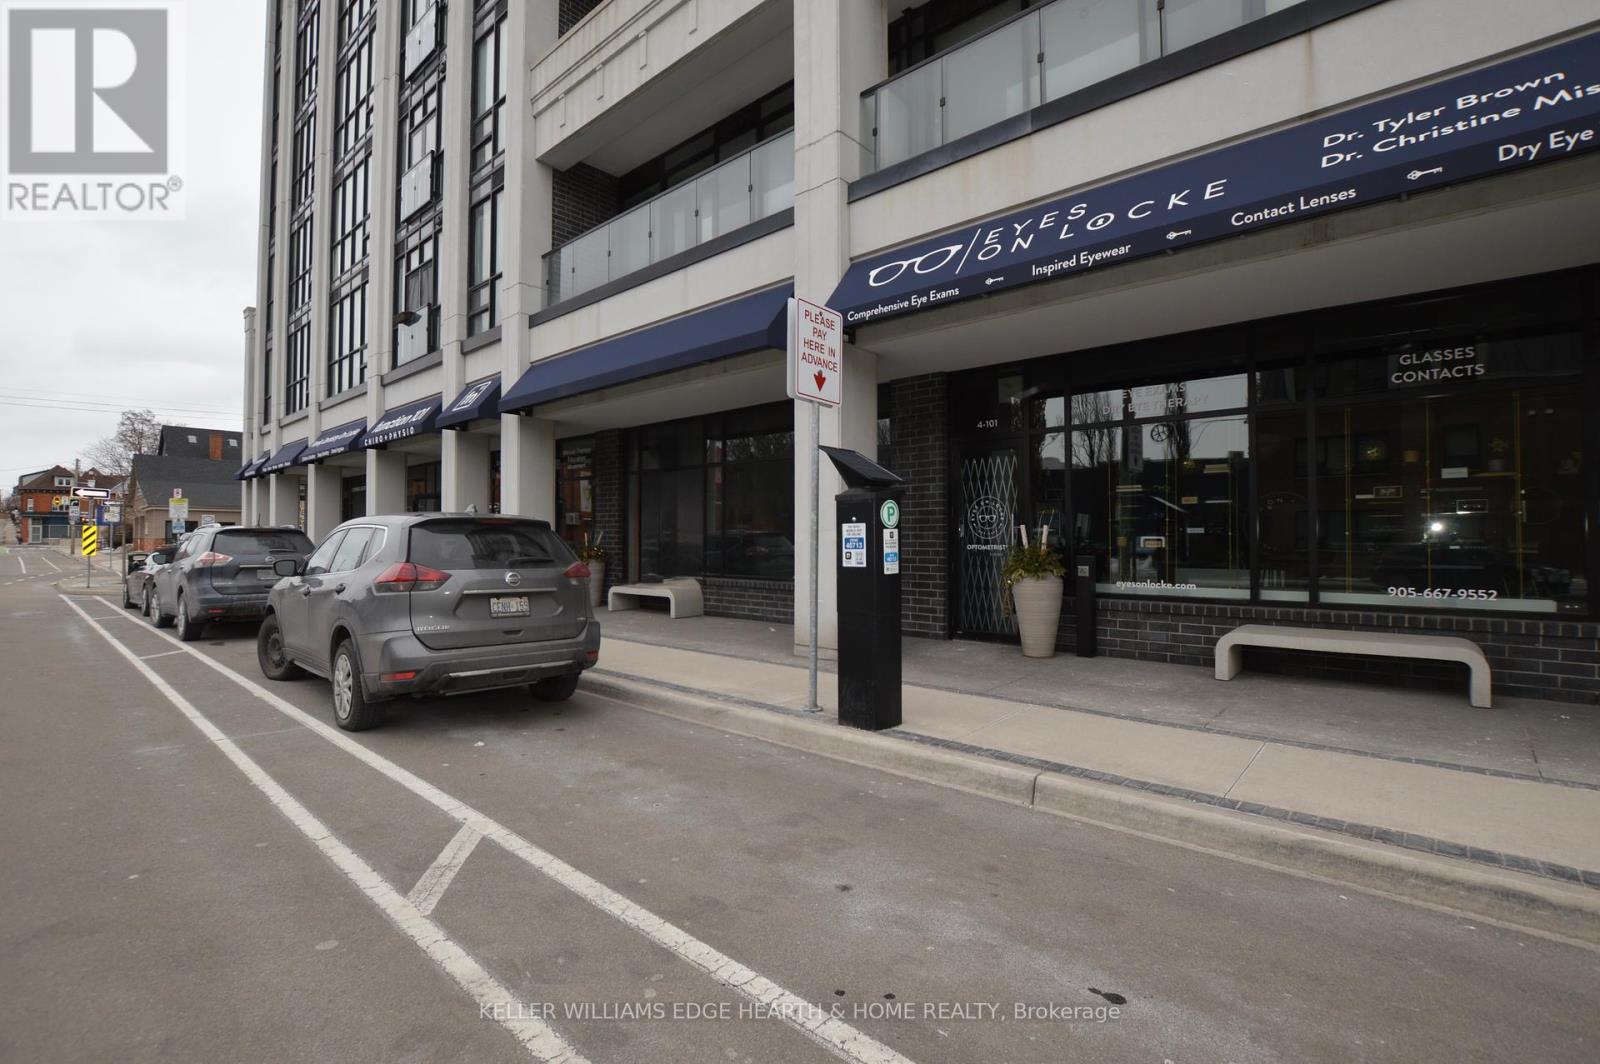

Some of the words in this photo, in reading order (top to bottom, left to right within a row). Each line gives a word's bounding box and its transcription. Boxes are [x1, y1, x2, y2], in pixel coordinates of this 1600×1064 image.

[1323, 132, 1364, 148] Dr.
[1372, 105, 1446, 134] Tyler
[1456, 72, 1565, 110] Brown
[1320, 152, 1364, 168] Dr.
[1372, 107, 1521, 152] Christine
[1534, 84, 1600, 110] Mis
[847, 300, 909, 322] Comprehensive
[911, 294, 928, 308] Eye
[930, 286, 960, 302] Exams
[1032, 254, 1077, 276] Inspired
[1080, 243, 1132, 265] Eyewear
[1231, 202, 1295, 226] Contact
[1300, 188, 1357, 210] Lenses
[1498, 142, 1542, 162] Dry
[1549, 130, 1594, 151] Eye
[977, 234, 1034, 261] ON
[1059, 179, 1228, 240] LOCKE
[984, 202, 1088, 245] EYES
[804, 309, 836, 331] PLEASE
[812, 327, 828, 341] PAY
[803, 337, 825, 355] HERE
[828, 346, 836, 358] IN
[1399, 346, 1475, 366] GLASSES
[801, 351, 838, 373] ADVANCE
[1391, 363, 1486, 384] CONTACTS
[976, 419, 998, 429] 4-101
[887, 506, 896, 523] P
[1116, 579, 1197, 590] eyesonlocke.com
[1387, 586, 1498, 601] 905-667-9552
